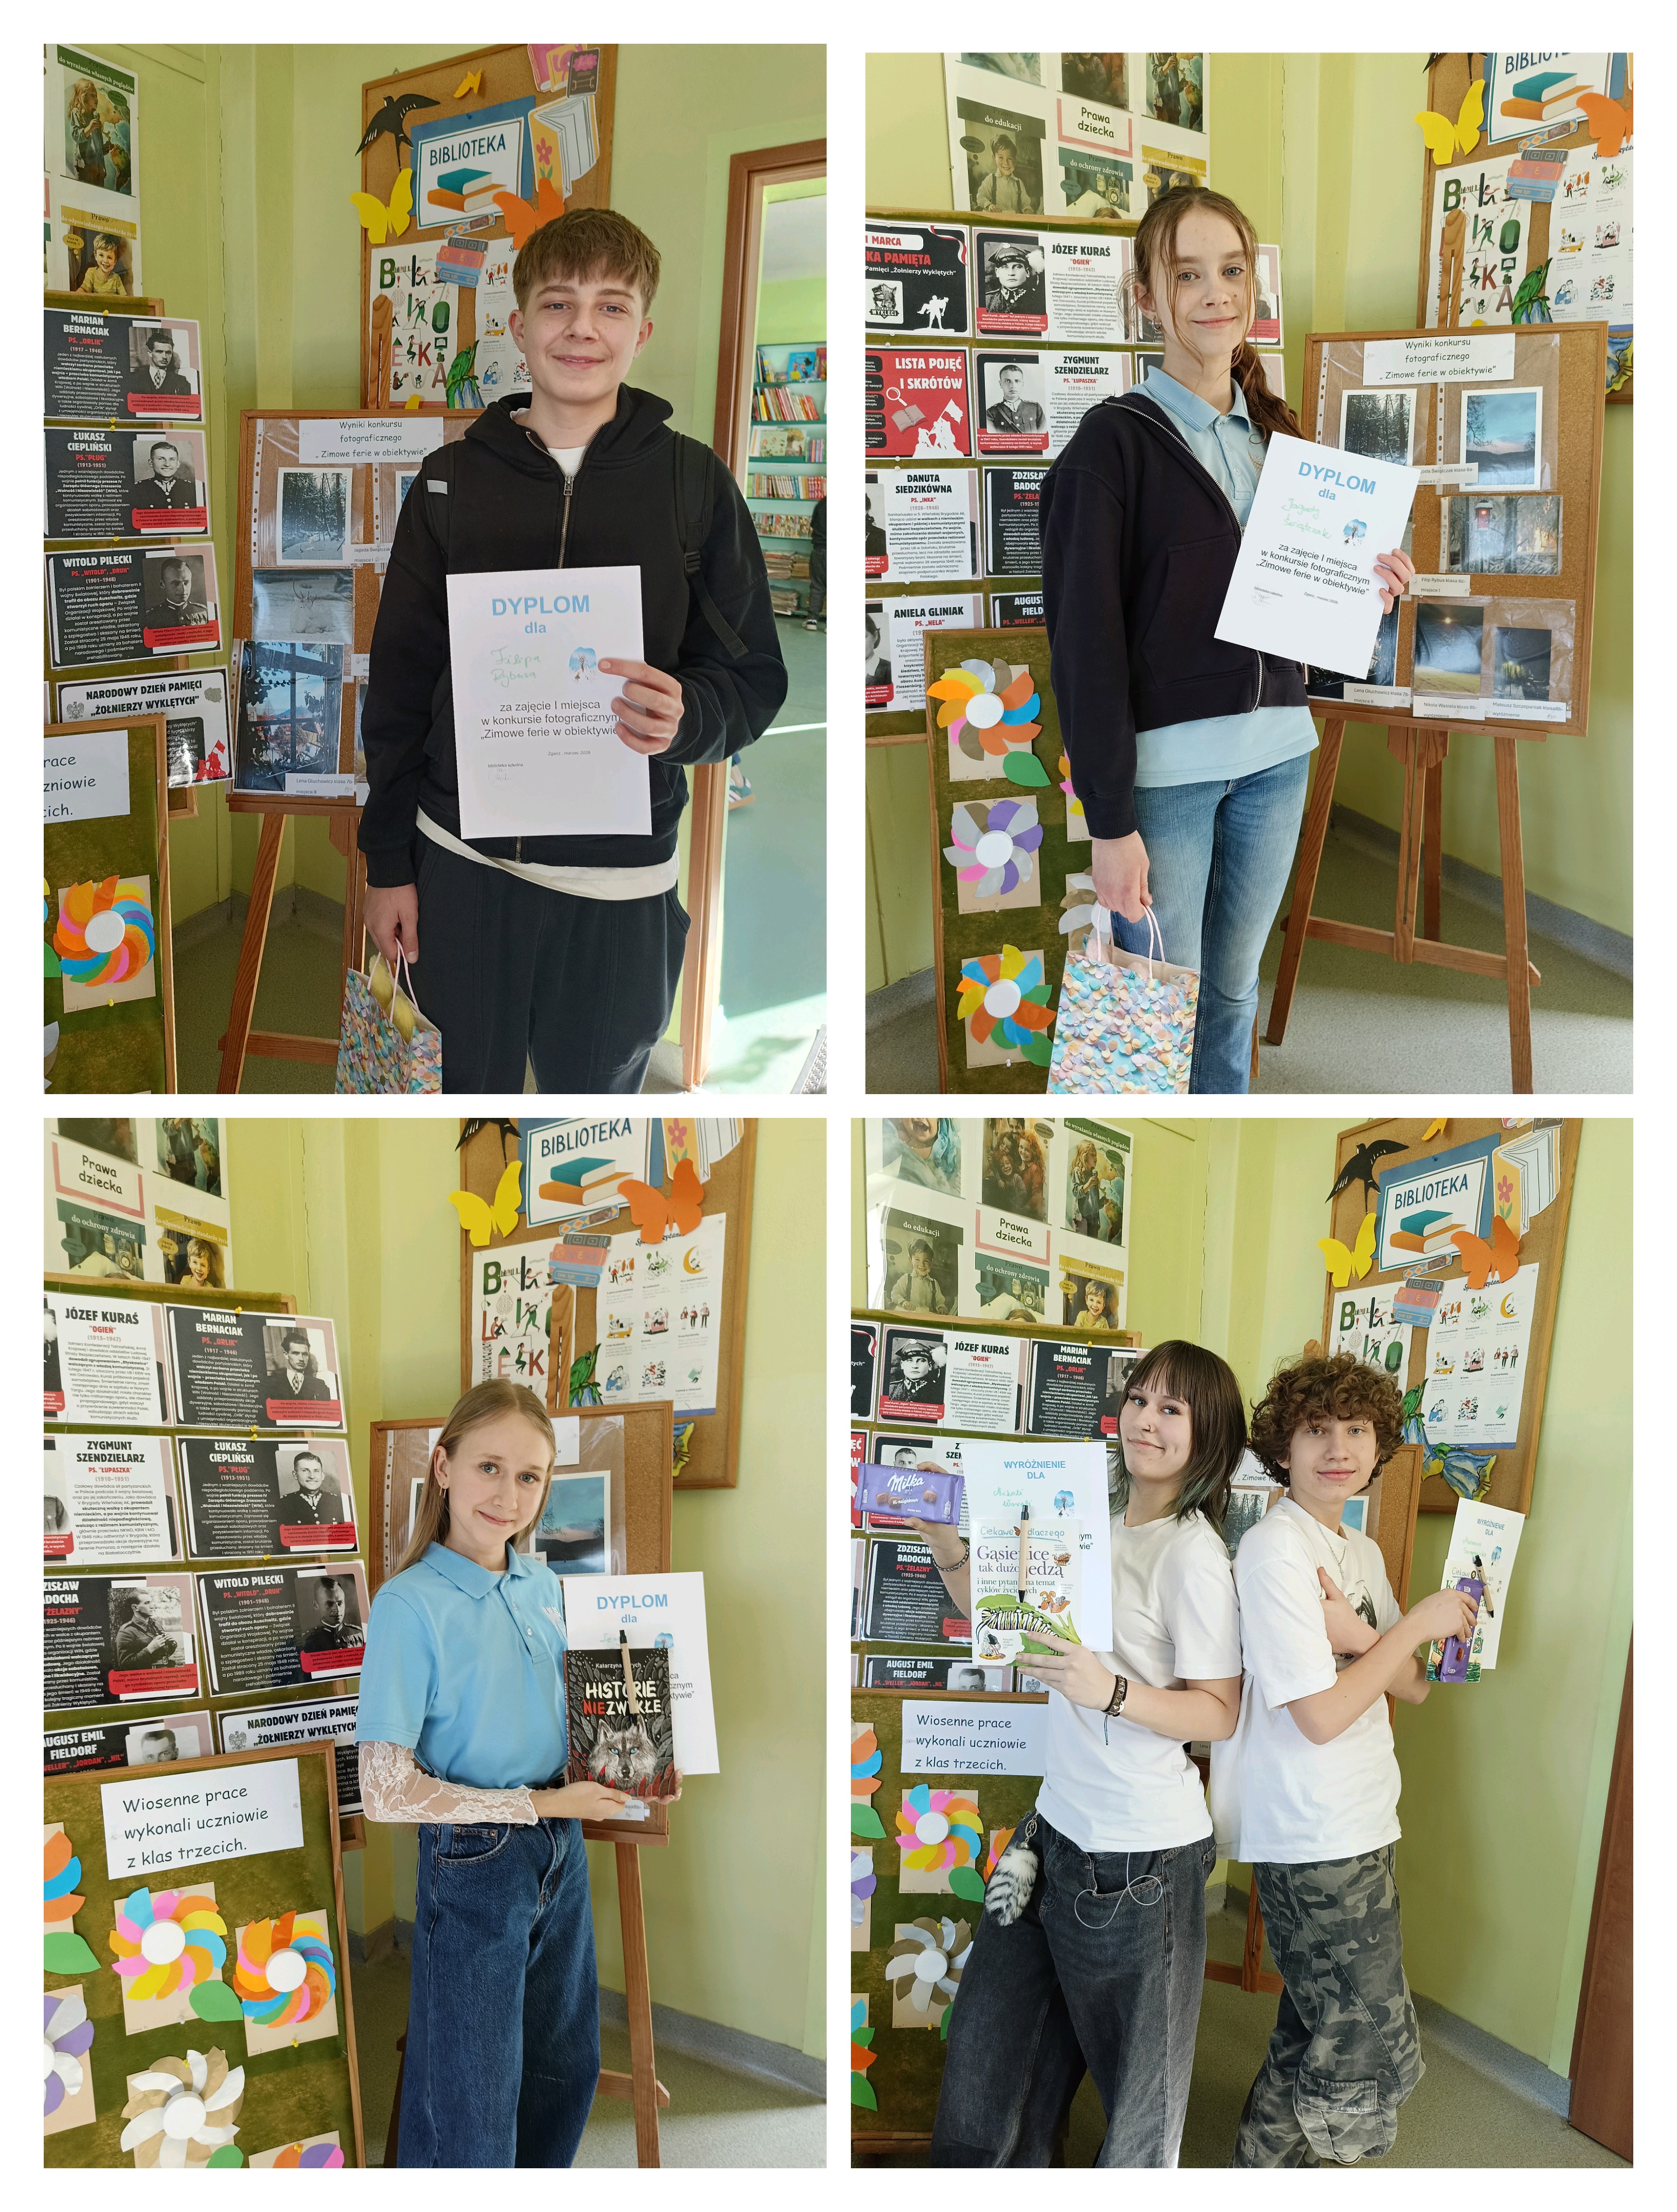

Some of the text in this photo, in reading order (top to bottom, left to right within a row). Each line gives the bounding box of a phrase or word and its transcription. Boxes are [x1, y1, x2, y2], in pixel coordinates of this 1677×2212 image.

[67, 60, 90, 73] wyrażania
[92, 71, 112, 82] własnych
[113, 79, 134, 92] poglądów
[1081, 107, 1110, 124] Prawa
[995, 119, 1022, 132] edukacji
[1078, 120, 1114, 138] dziecka
[430, 133, 505, 166] BIBLIOTEKA
[1079, 162, 1101, 172] ochrony
[1103, 167, 1124, 177] zdrowia
[92, 213, 109, 222] Prawo
[872, 236, 901, 246] MARCA
[1052, 243, 1111, 257] JÓZEF KURAŚ
[884, 253, 931, 267] PAMIĘTA
[71, 315, 104, 325] MARIAN
[63, 325, 109, 336] BERNACIAK
[896, 356, 961, 371] LISTA POJĘĆ
[901, 376, 962, 389] I SKRÓTÓW
[73, 432, 105, 441] ŁUKASZ
[340, 434, 402, 443] fotograficznego
[67, 441, 112, 451] CIEPLIŃSKI
[907, 474, 939, 482] DANUTA
[1298, 462, 1376, 495] DYPLOM
[896, 484, 952, 493] SIEDZIKÓWNA
[1318, 488, 1336, 501] dla
[63, 555, 132, 568] WITOLD PILECKI
[1290, 546, 1319, 561] zajęcie
[1326, 556, 1357, 571] miejsca
[1270, 551, 1308, 567] konkursie
[1311, 562, 1370, 585] fotograficznym
[1294, 569, 1311, 580] ferie
[492, 595, 589, 616] DYPLOM
[894, 606, 963, 618] ANIELA GLINIAK
[525, 622, 546, 633] dla
[491, 646, 541, 667] Filipa
[86, 680, 202, 700] NARODOWY DZIEŃ PAMIĘCI
[516, 702, 551, 713] zajęcie
[561, 701, 600, 711] miejsca
[493, 714, 542, 725] konkursie
[528, 727, 550, 737] ferie
[1395, 1174, 1468, 1209] BIBLIOTEKA
[87, 1441, 132, 1451] ZYGMUNT
[77, 1453, 145, 1462] SZENDZIELARZ
[1004, 1459, 1066, 1468] WYRÓŻNIENIE
[887, 1474, 924, 1493] Milka
[1477, 1518, 1505, 1530] WYRÓŻNIENIE
[980, 1526, 1064, 1539] Ciekawe dlaczego
[977, 1546, 1049, 1561] Gąsieice
[979, 1562, 992, 1572] tak
[978, 1586, 1037, 1595] cyklów życioych
[887, 1661, 934, 1669] AUGUST EMIL
[893, 1670, 927, 1678] FIELDORF
[583, 1699, 661, 1716] NIEZWKŁE
[123, 1786, 248, 1812] Wiosenne prace
[125, 1808, 268, 1840] wykonali uczniowie
[127, 1838, 246, 1868] z klas trzecich.
